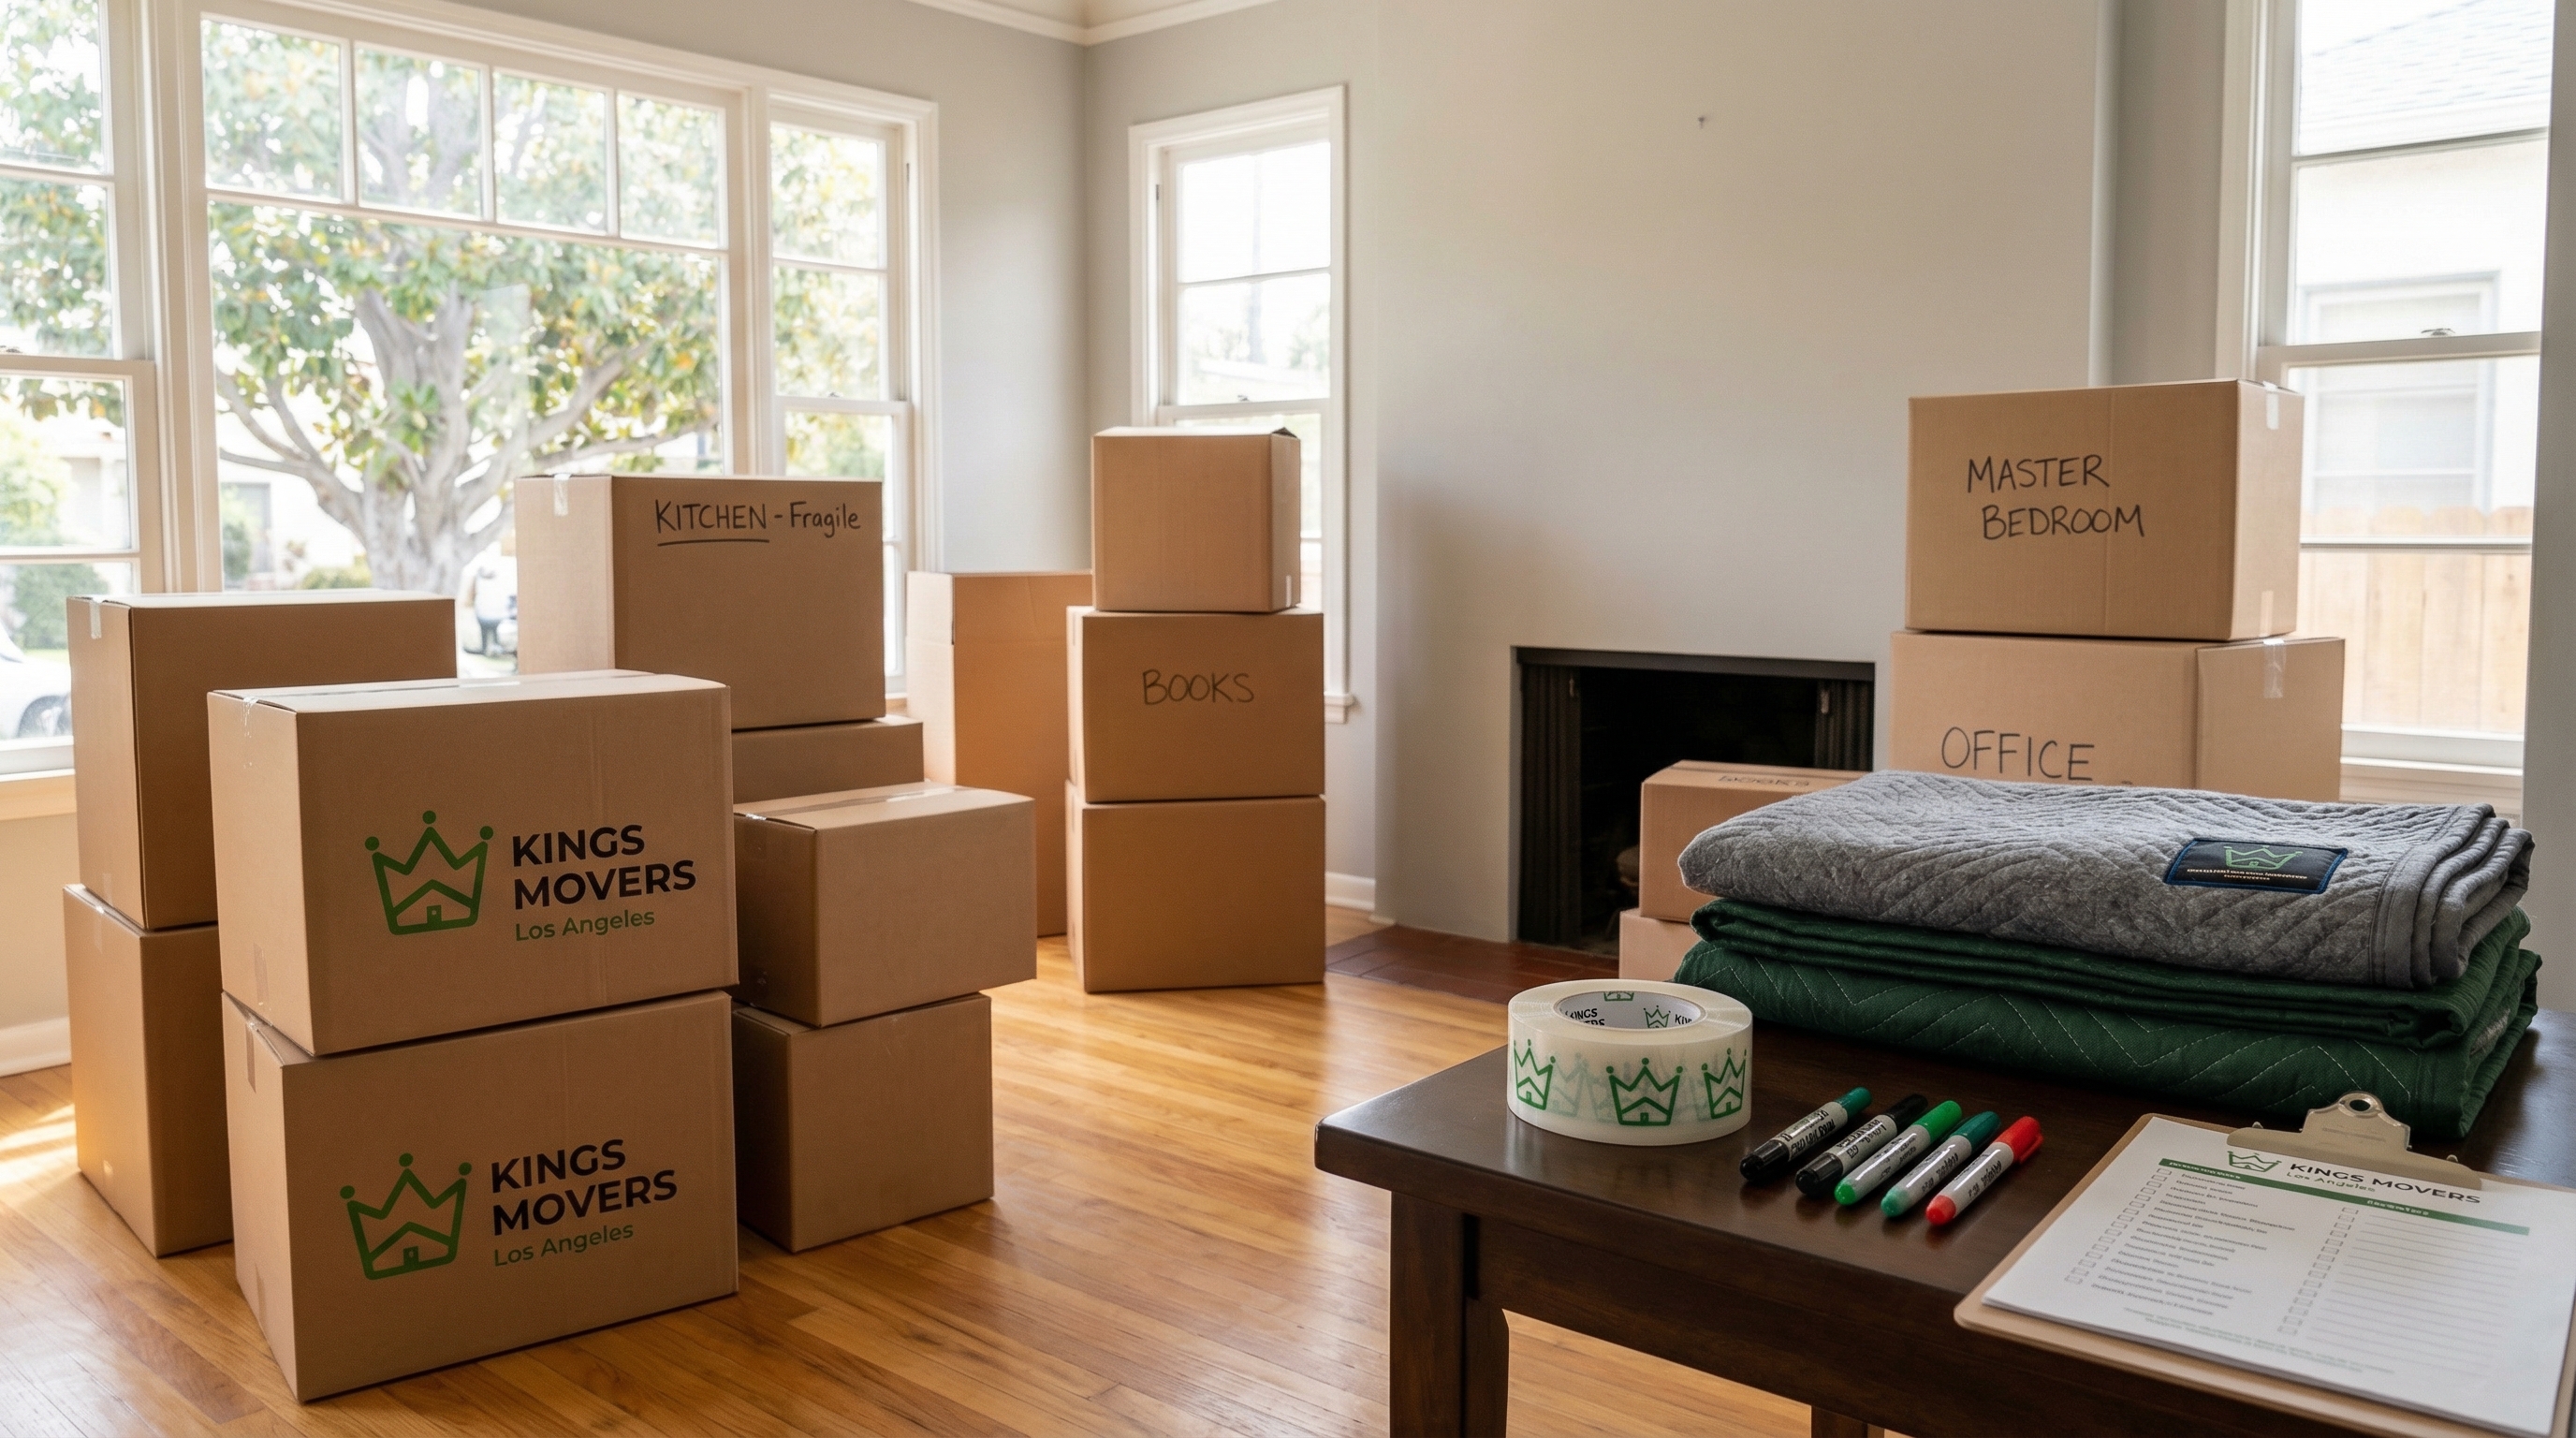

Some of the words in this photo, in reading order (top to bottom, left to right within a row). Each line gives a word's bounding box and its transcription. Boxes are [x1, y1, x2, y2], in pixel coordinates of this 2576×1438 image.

[1967, 454, 2110, 493] MASTER
[655, 499, 768, 534] KITCHEN
[790, 501, 861, 538] Fragile
[1982, 504, 2145, 540] BEDROOM
[1142, 668, 1254, 705] BOOKS
[1941, 726, 2095, 782] OFFICE
[512, 824, 646, 867] KINGS
[514, 859, 696, 910] MOVERS
[515, 923, 556, 942] Los
[562, 909, 655, 936] Angeles
[491, 1138, 626, 1194] KINGS
[2290, 1164, 2364, 1182] KINGS
[2372, 1178, 2481, 1204] MOVERS
[492, 1169, 678, 1237] MOVERS
[494, 1245, 534, 1267] Los
[540, 1225, 634, 1257] Angeles
